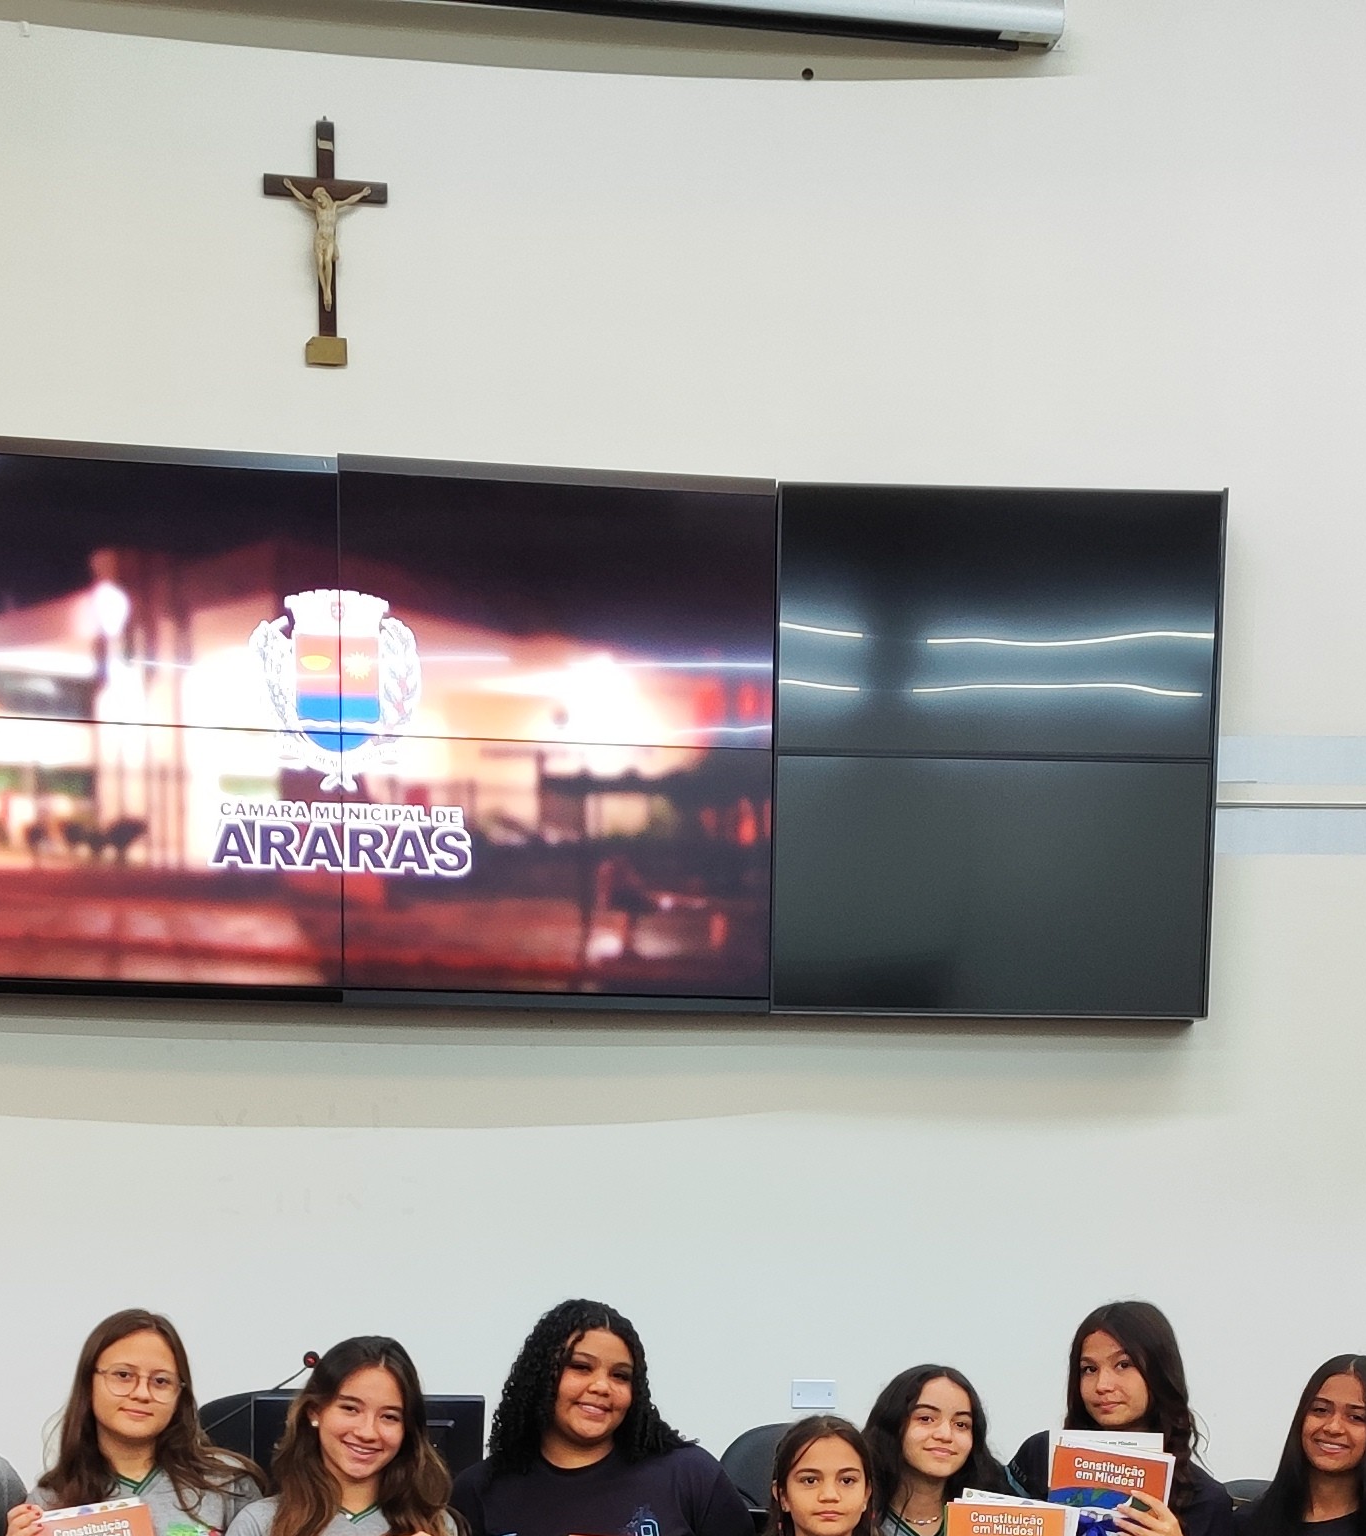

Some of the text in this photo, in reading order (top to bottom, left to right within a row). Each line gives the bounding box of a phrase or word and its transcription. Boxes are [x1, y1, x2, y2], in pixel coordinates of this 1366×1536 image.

[315, 806, 426, 823] MUNICIPAL
[436, 810, 460, 824] DE
[211, 823, 468, 872] ARARAS
[1075, 1457, 1145, 1477] Constituição
[1075, 1470, 1144, 1488] em Miúdos II
[970, 1512, 1044, 1527] Constituição
[972, 1524, 1043, 1536] em Miúdos II
